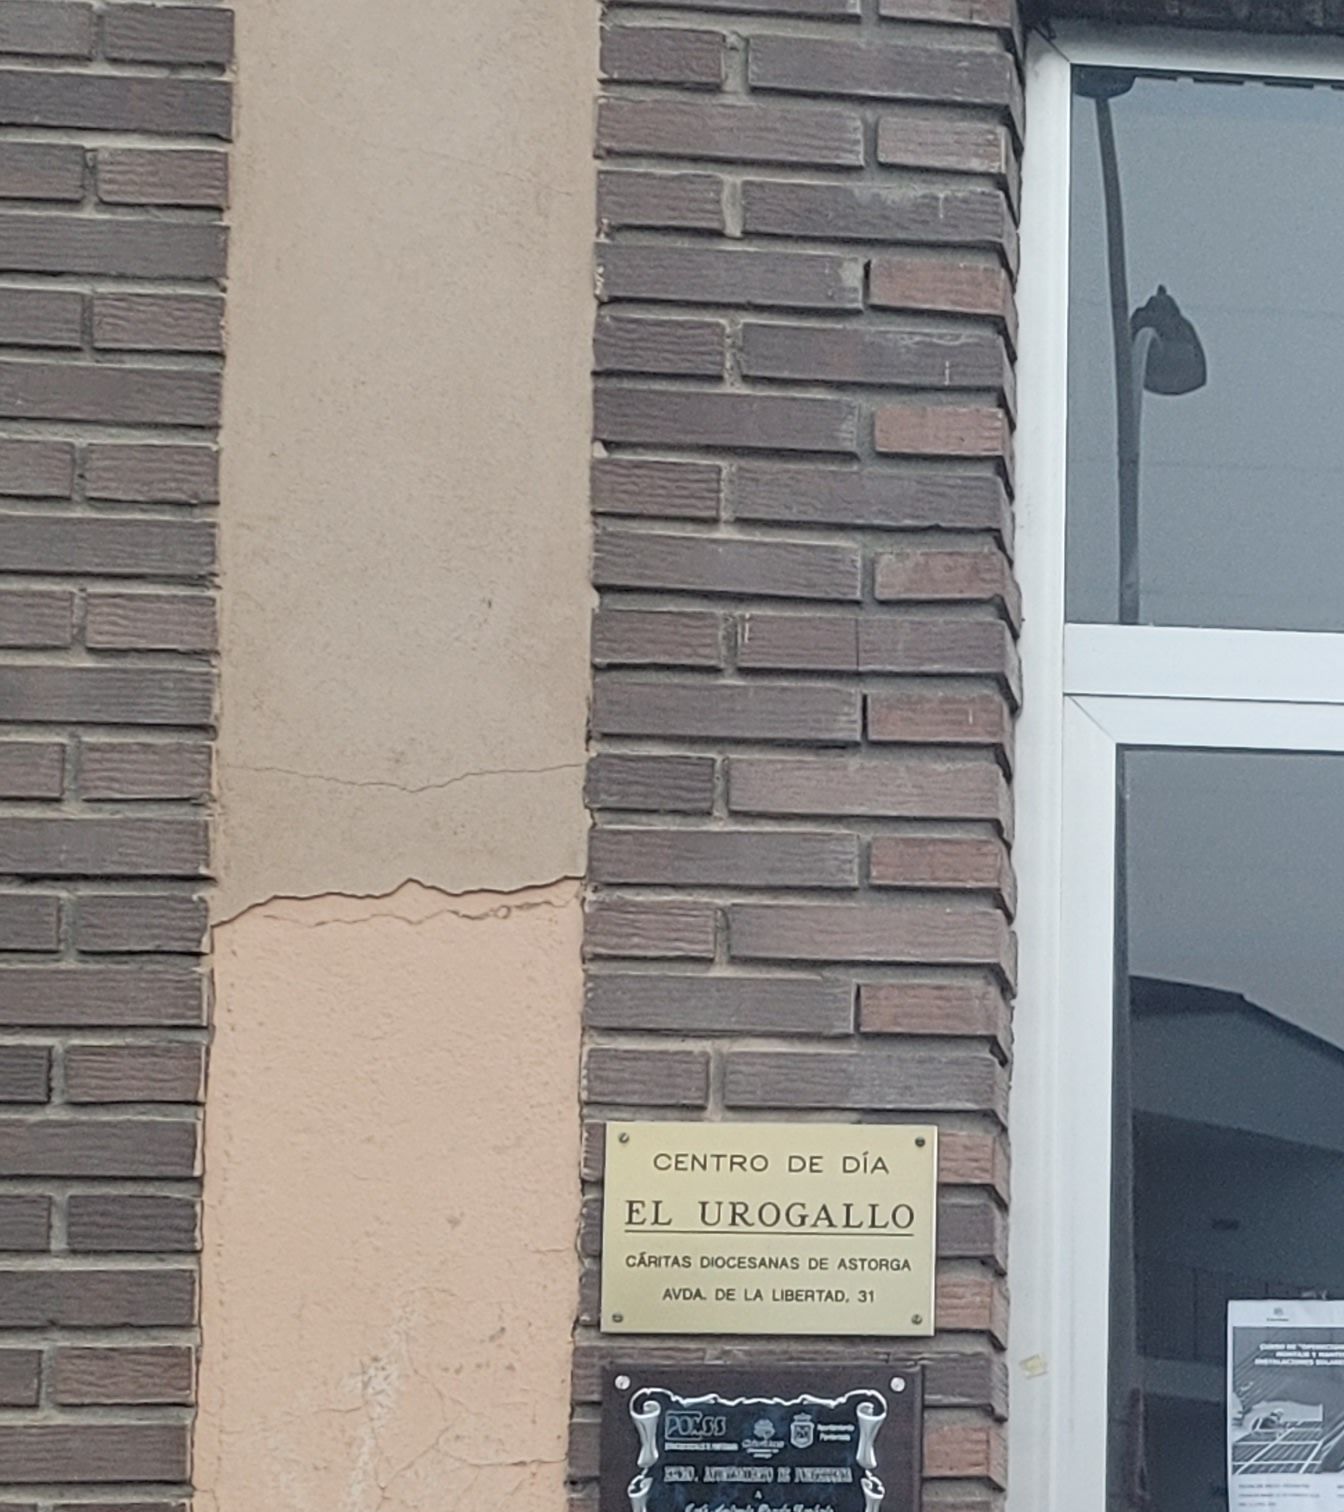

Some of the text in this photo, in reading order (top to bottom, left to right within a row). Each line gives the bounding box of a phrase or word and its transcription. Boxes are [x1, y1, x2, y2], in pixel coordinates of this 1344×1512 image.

[653, 1151, 889, 1175] CENTRO DE DÍA
[624, 1199, 914, 1229] EL UROGALLO
[625, 1251, 912, 1272] CÁRITAS DIOCESANAS DE ASTORGA
[662, 1288, 875, 1303] AVDA. DE LA LIBERTAD, 31
